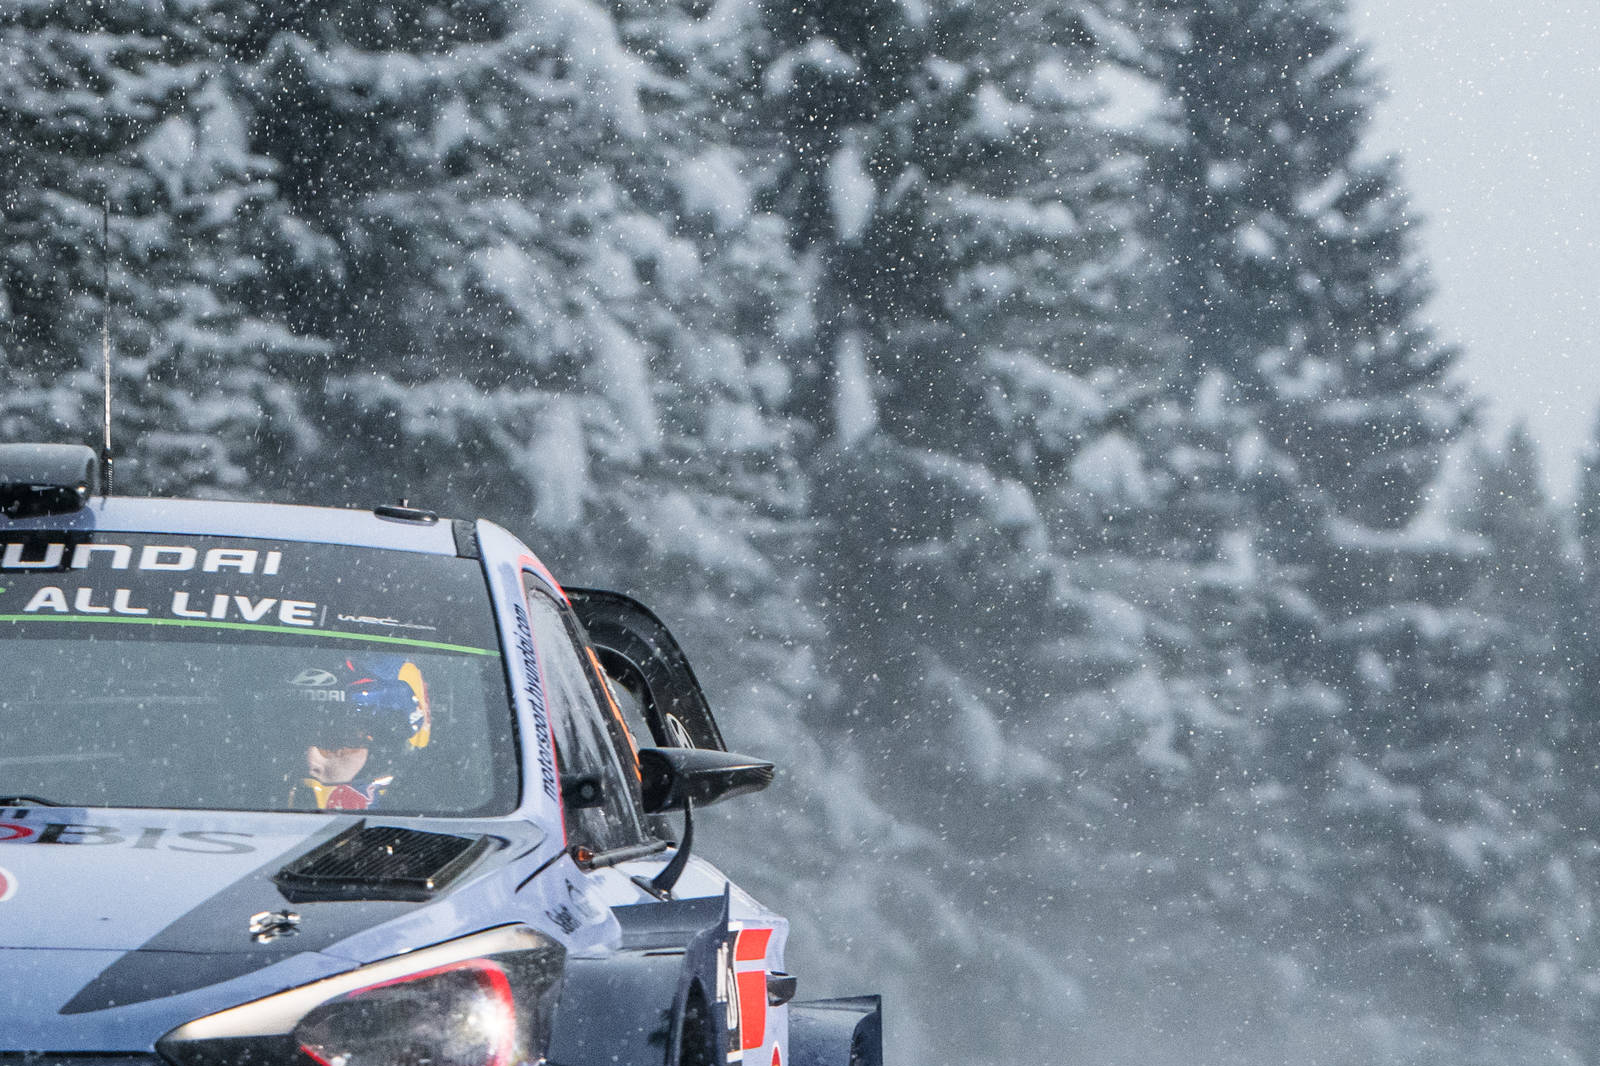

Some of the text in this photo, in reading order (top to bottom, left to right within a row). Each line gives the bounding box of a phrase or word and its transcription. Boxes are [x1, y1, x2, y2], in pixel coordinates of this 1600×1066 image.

[23, 586, 149, 616] ALL
[171, 591, 317, 627] LIVE
[512, 602, 557, 802] motorsport.hyundai.com
